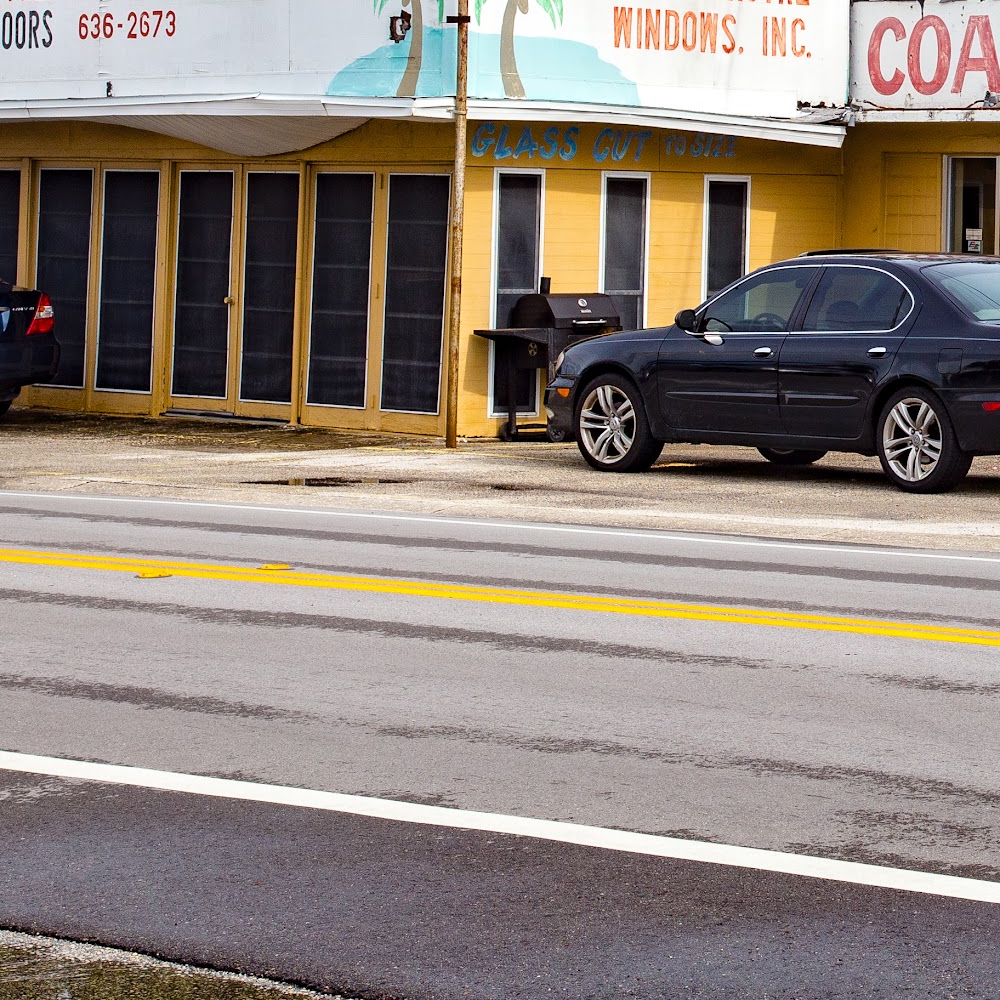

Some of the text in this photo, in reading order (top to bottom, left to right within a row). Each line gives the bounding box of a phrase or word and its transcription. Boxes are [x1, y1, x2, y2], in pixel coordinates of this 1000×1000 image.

[78, 10, 177, 40] 636-2673
[762, 15, 812, 59] INC.
[470, 121, 739, 163] GLASS CUT TO SIZE
